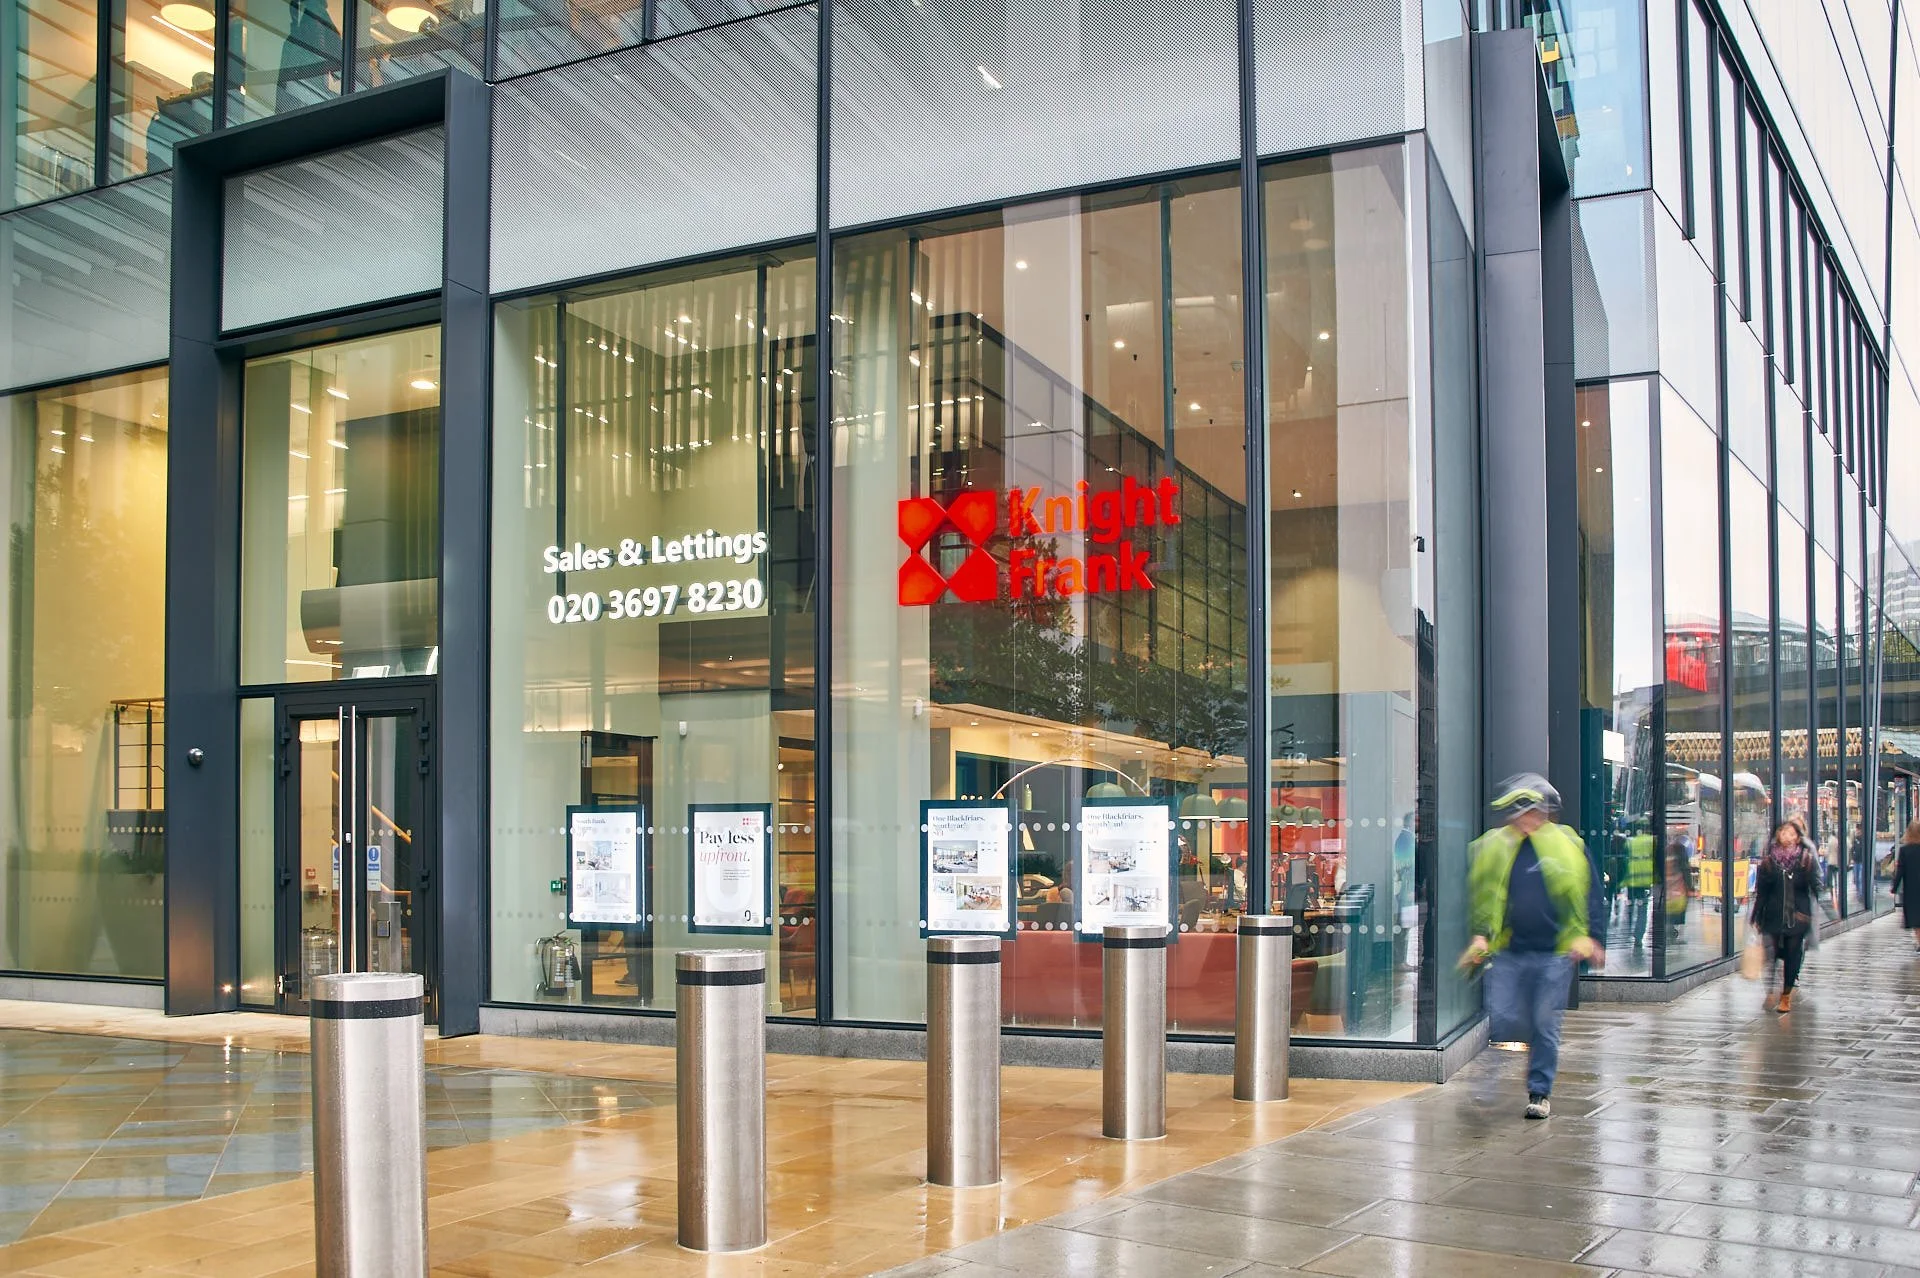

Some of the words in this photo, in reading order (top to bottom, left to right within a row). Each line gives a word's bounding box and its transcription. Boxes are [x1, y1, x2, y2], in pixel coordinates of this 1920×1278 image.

[1009, 476, 1180, 543] Knight
[543, 542, 612, 574] Sales
[618, 538, 646, 566] &
[651, 529, 770, 564] Lettings
[1009, 541, 1156, 599] Frank
[548, 592, 602, 624] 020
[608, 584, 682, 619] 3697
[687, 579, 766, 613] 8230
[700, 831, 725, 848] Pay
[728, 830, 755, 844] less
[700, 849, 750, 865] upfront.
